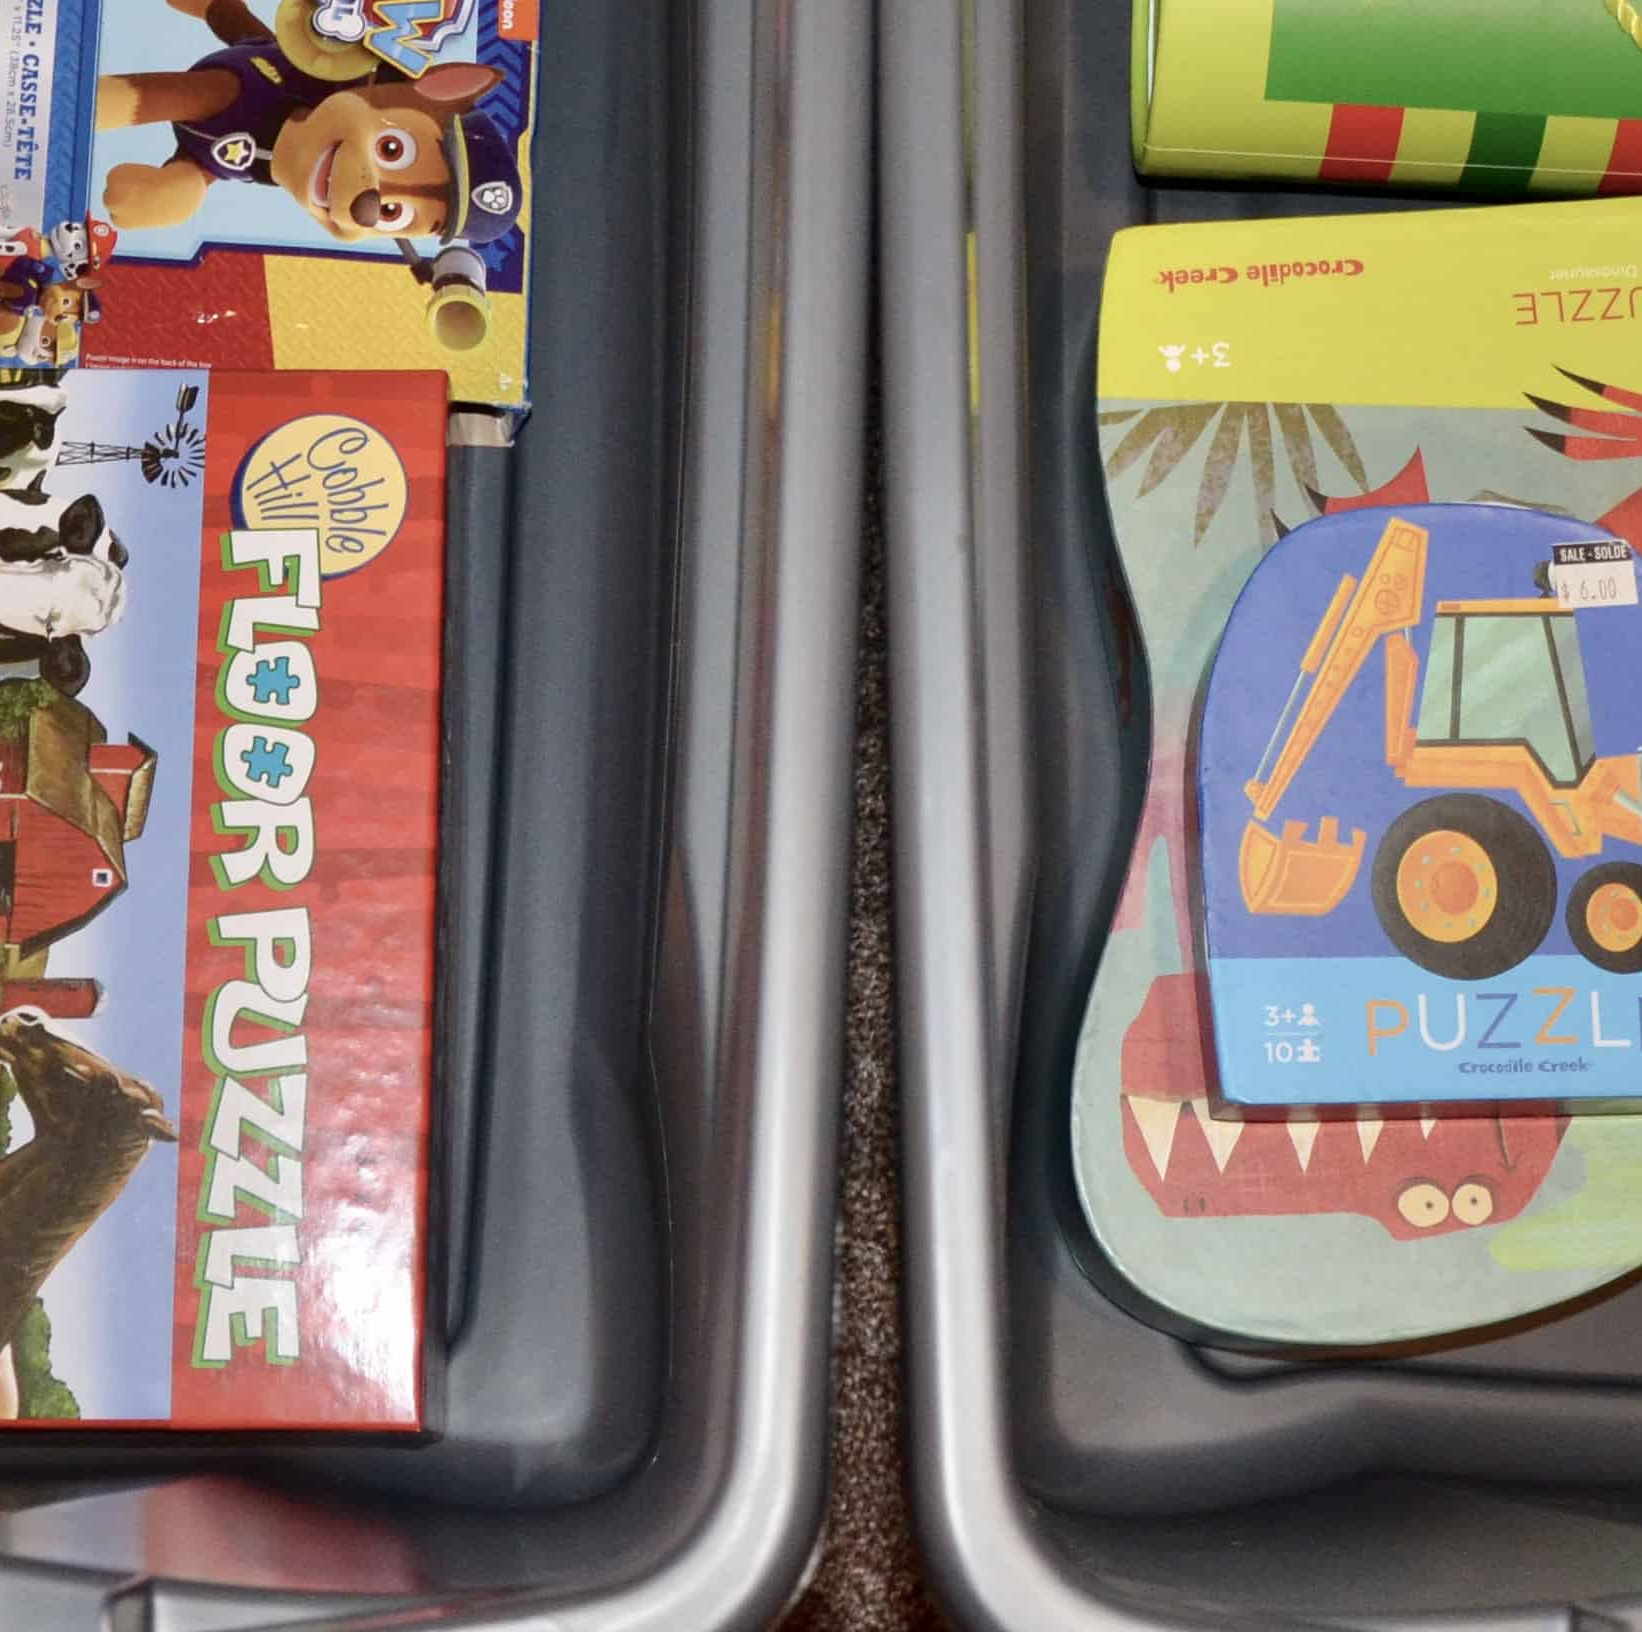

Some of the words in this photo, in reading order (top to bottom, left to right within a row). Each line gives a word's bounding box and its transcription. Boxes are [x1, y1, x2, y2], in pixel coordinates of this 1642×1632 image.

[14, 54, 41, 181] CASSE-TÊTE
[1160, 266, 1239, 294] Creek
[1246, 259, 1365, 287] Crocodile
[1191, 340, 1232, 368] 3+
[246, 452, 320, 521] Hill
[307, 427, 390, 554] Cobble
[1559, 547, 1585, 562] SALE
[1594, 544, 1628, 561] SOLDE
[1580, 577, 1618, 601] 6.00
[211, 527, 323, 894] FLOOR
[1263, 1004, 1296, 1027] 3+
[1264, 1042, 1294, 1063] 10
[1458, 1057, 1533, 1074] Crocodile
[1538, 1056, 1590, 1073] Creek
[193, 904, 312, 1370] PUZZLE
